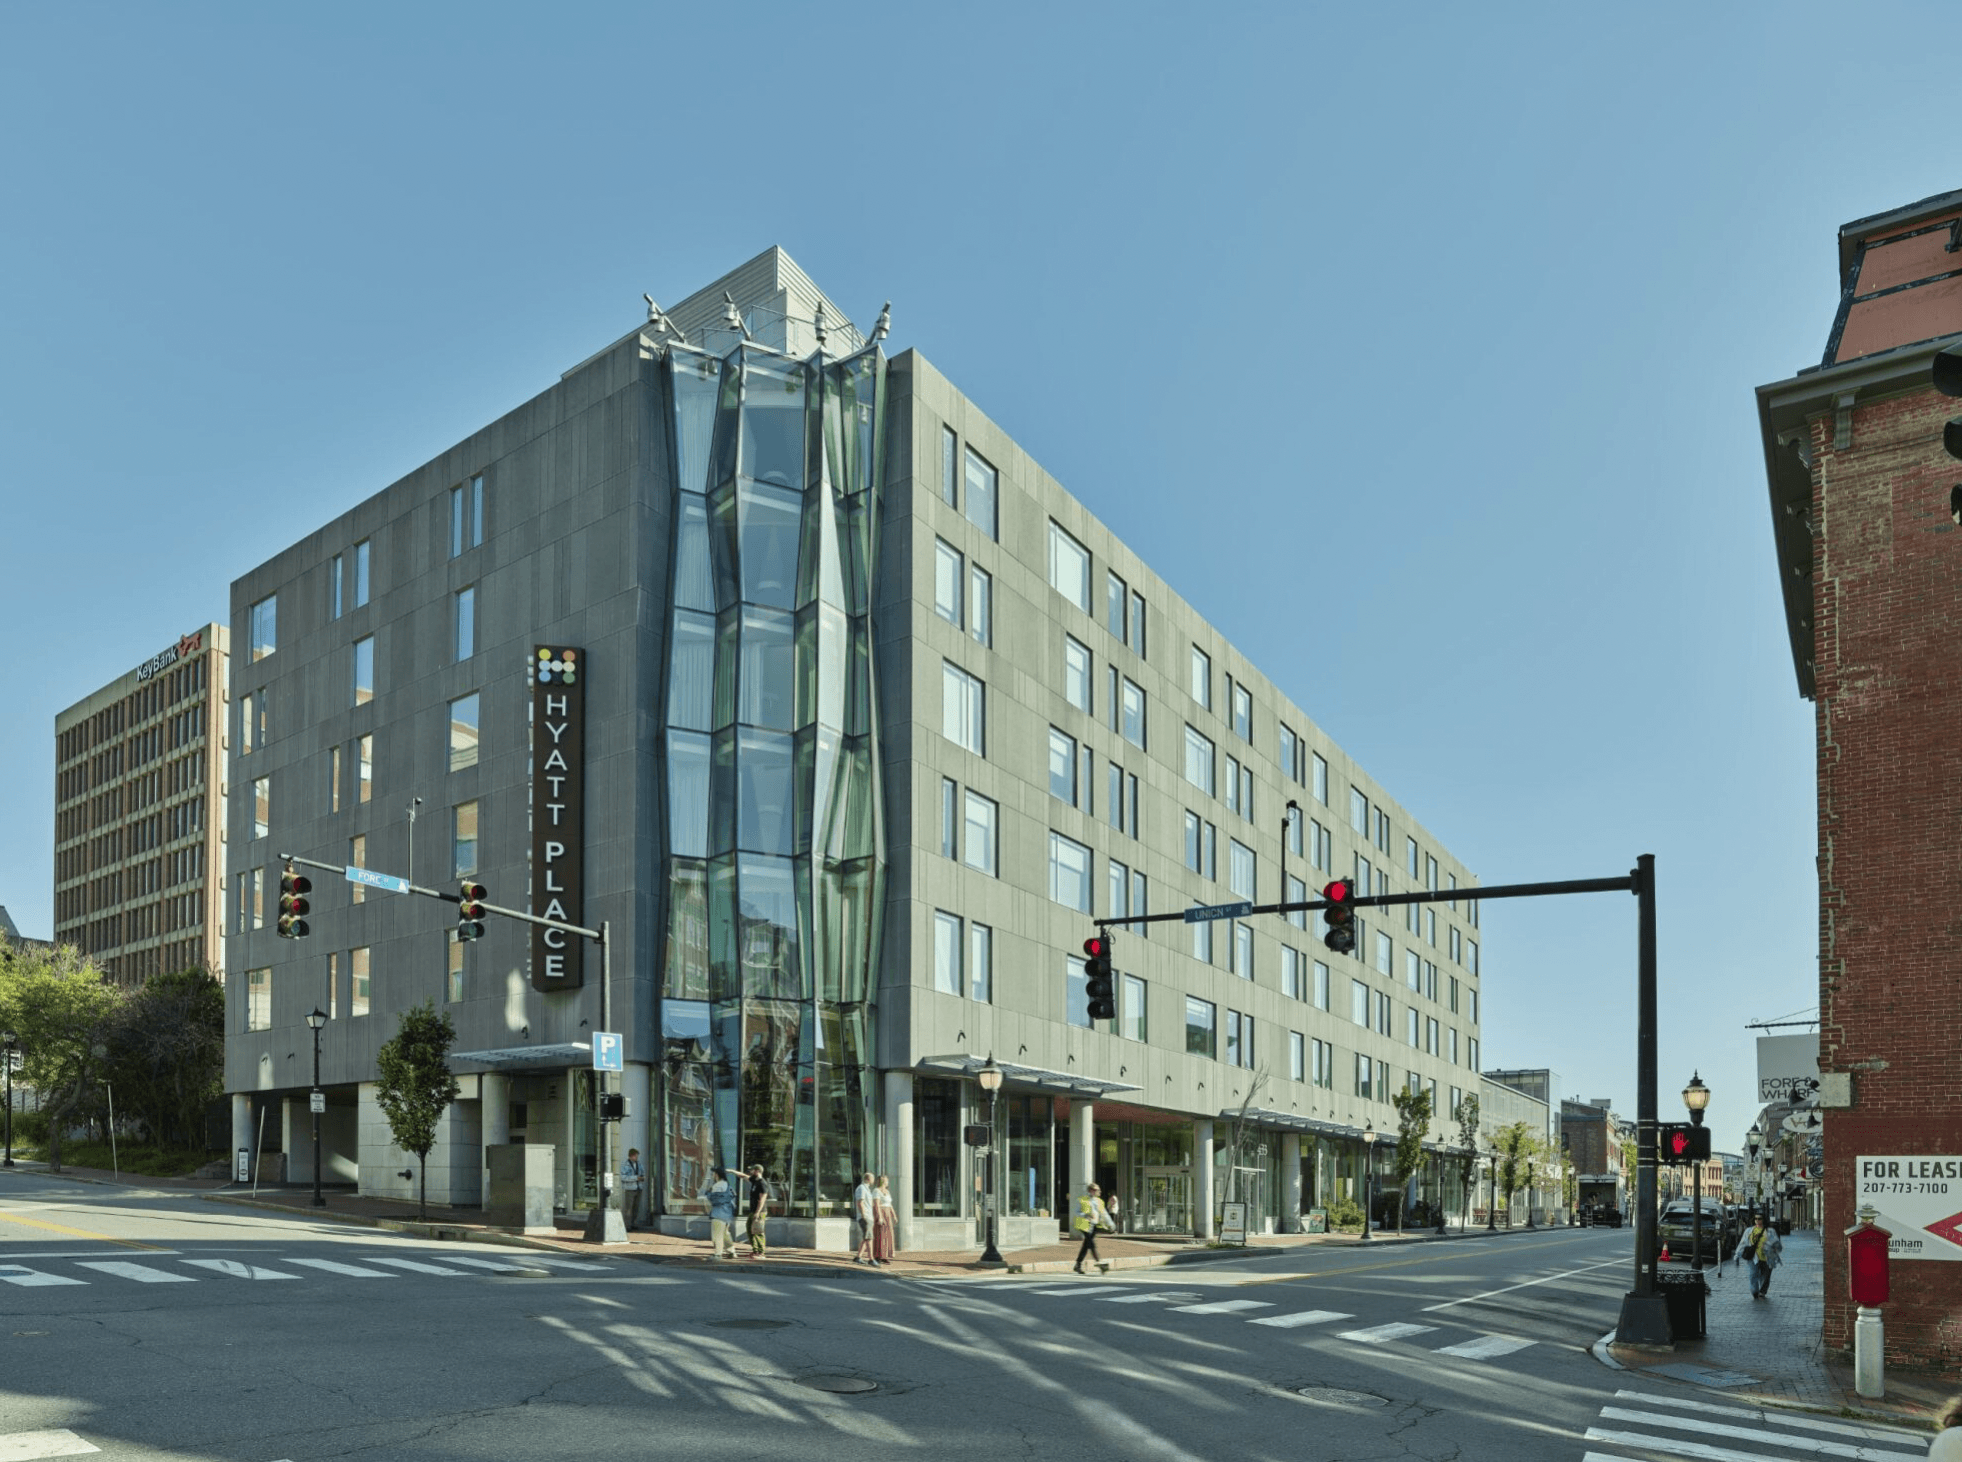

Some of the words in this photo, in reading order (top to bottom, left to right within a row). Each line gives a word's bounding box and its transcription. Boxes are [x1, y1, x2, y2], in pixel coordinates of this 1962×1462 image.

[137, 646, 178, 681] KeyBank
[544, 694, 568, 825] HYATT
[543, 841, 568, 978] PLACE
[601, 1036, 616, 1054] P
[1761, 1077, 1801, 1089] FORE
[1863, 1161, 1899, 1178] FOR
[1908, 1161, 1962, 1178] LEAS
[1863, 1182, 1948, 1194] 207-773-7100
[1888, 1238, 1923, 1248] unham
